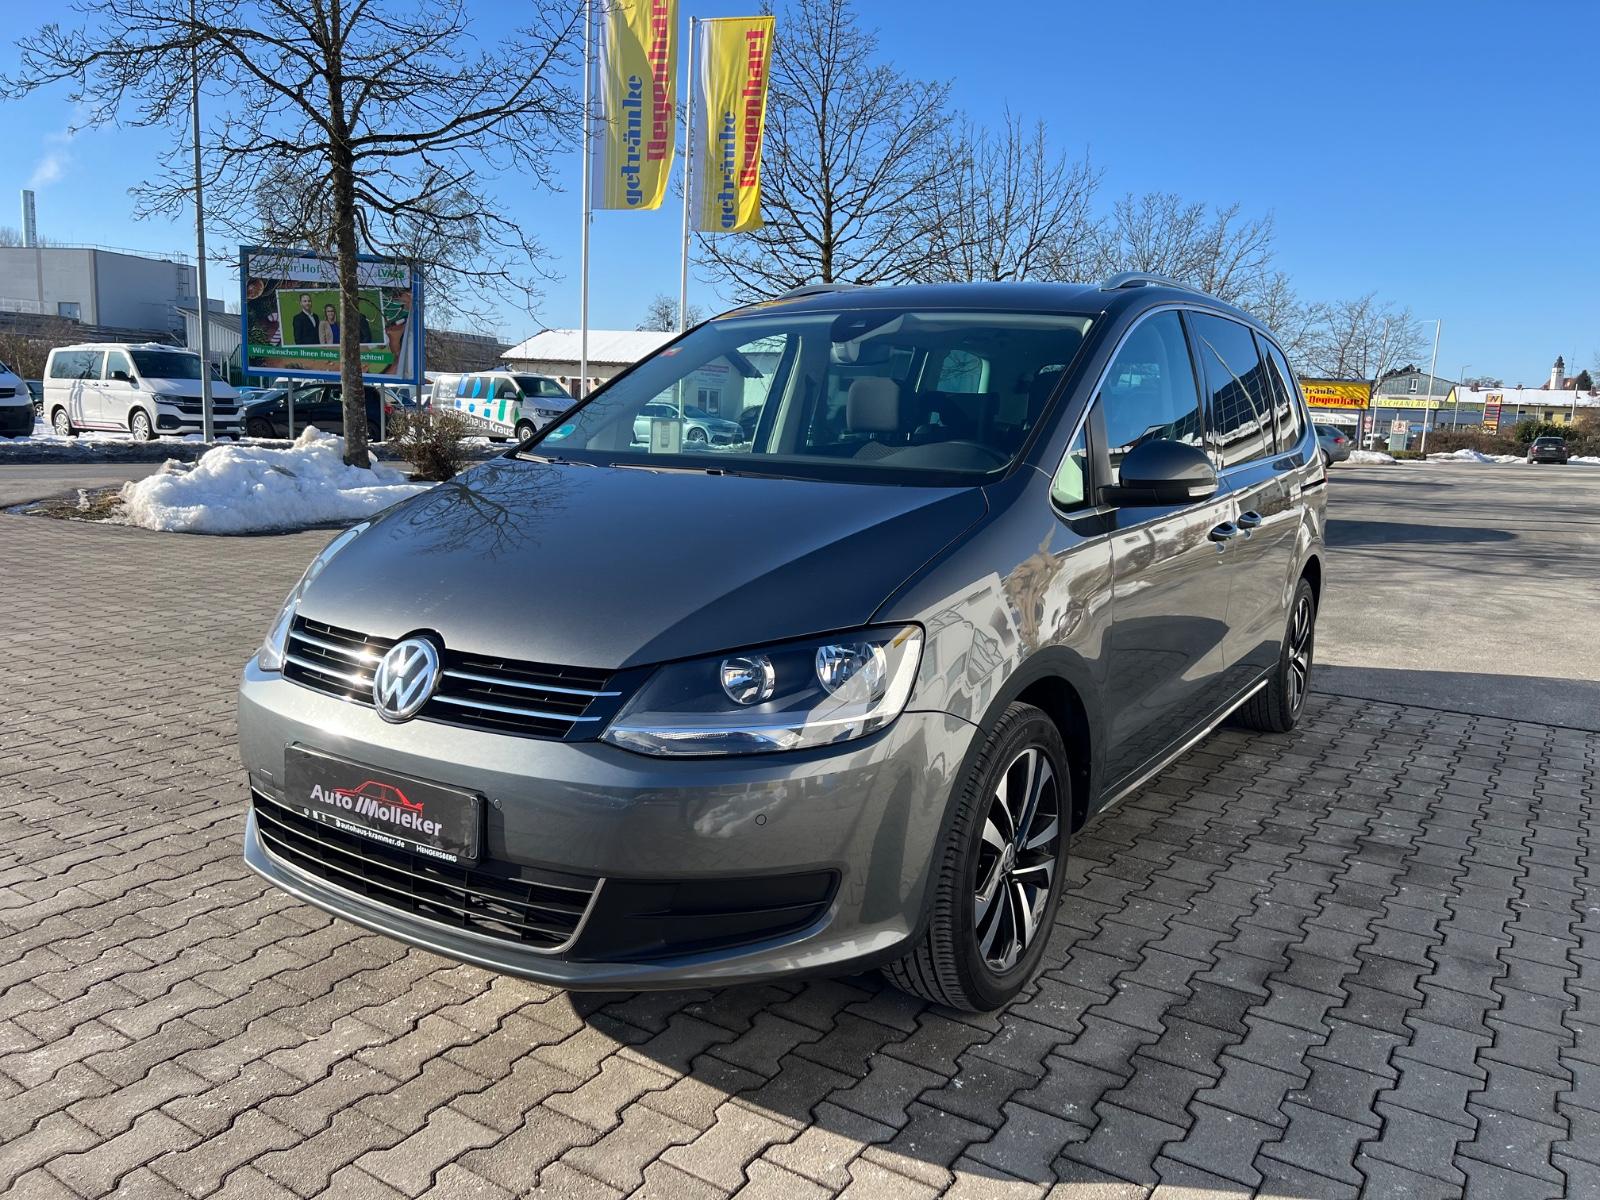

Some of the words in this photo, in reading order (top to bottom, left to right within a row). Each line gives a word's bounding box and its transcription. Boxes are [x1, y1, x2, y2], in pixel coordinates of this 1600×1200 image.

[647, 0, 672, 161] Degenhar
[621, 75, 643, 205] getränke
[717, 111, 736, 228] getränke
[302, 263, 319, 273] Hof
[1371, 399, 1438, 408] WASCHANLAGN
[489, 421, 515, 436] Kraus
[310, 784, 352, 810] Auto
